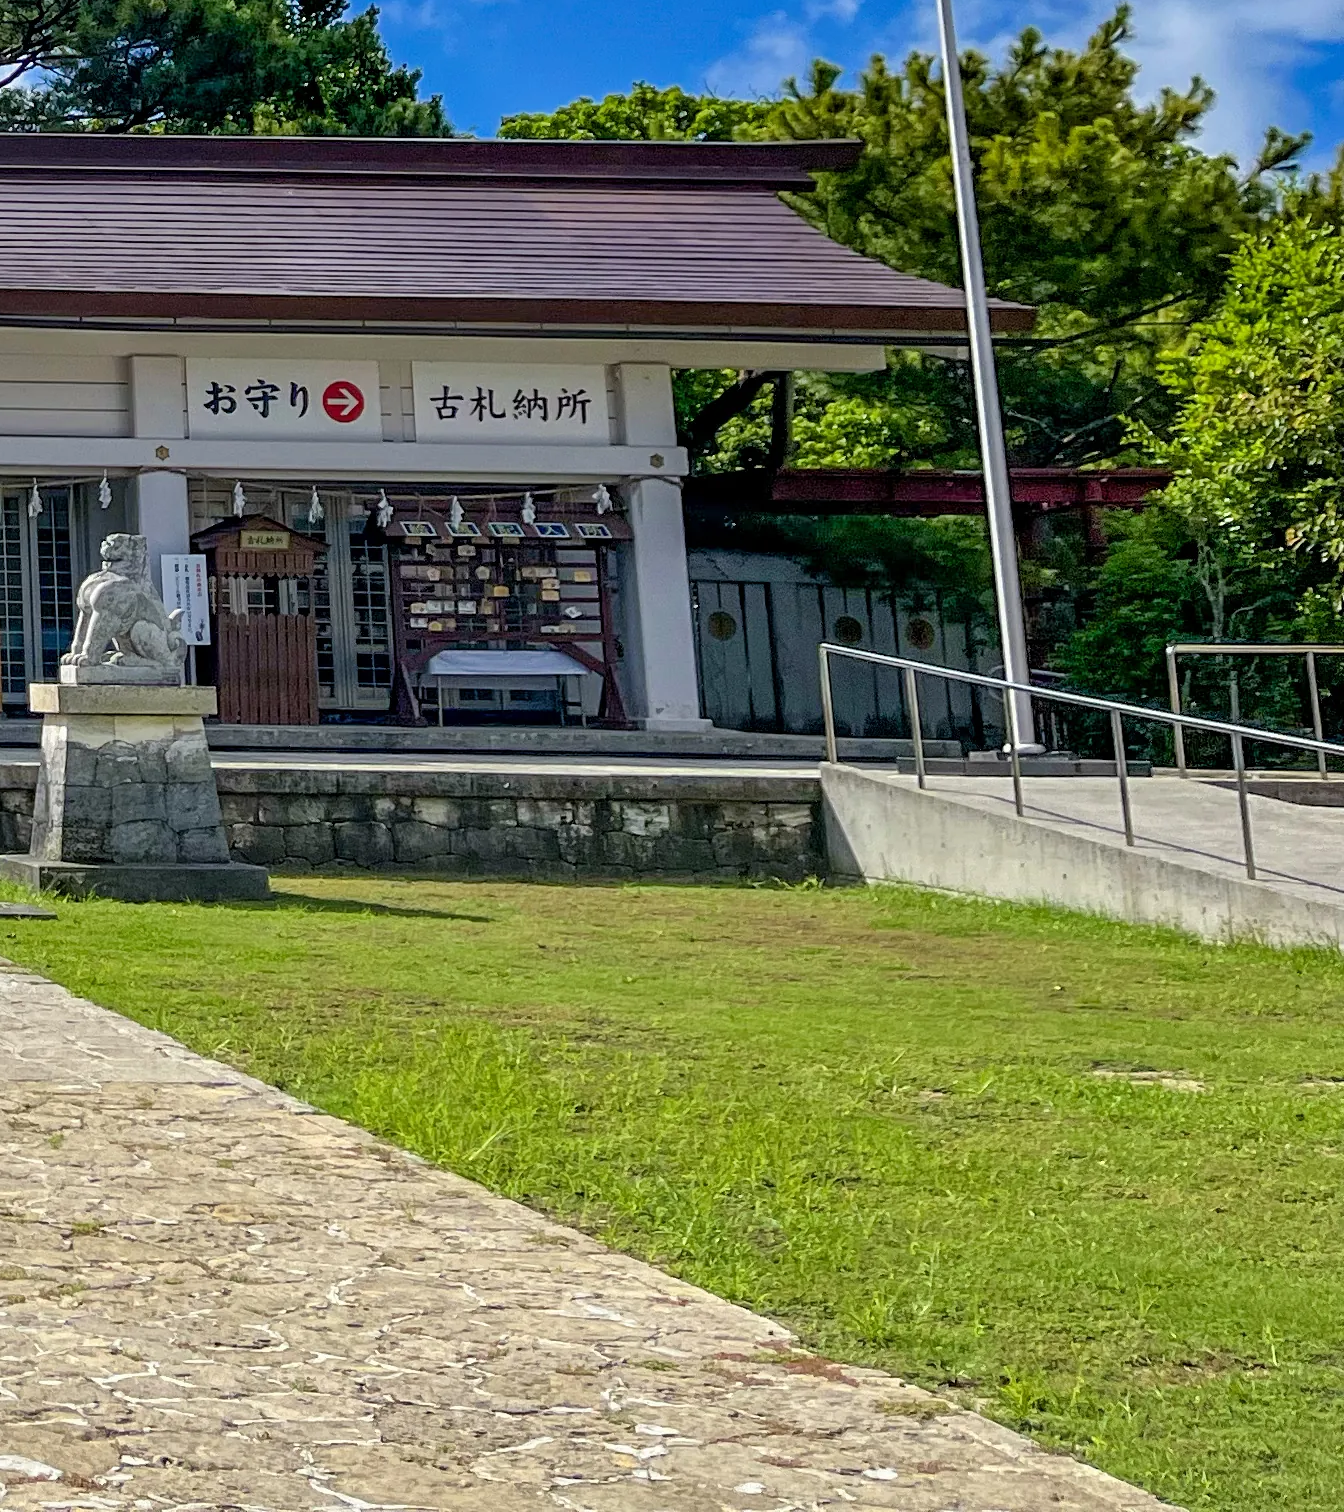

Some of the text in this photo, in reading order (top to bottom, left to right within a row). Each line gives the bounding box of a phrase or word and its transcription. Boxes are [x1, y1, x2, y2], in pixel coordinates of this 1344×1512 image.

[203, 378, 310, 419] お守り
[429, 384, 593, 425] 古札納所
